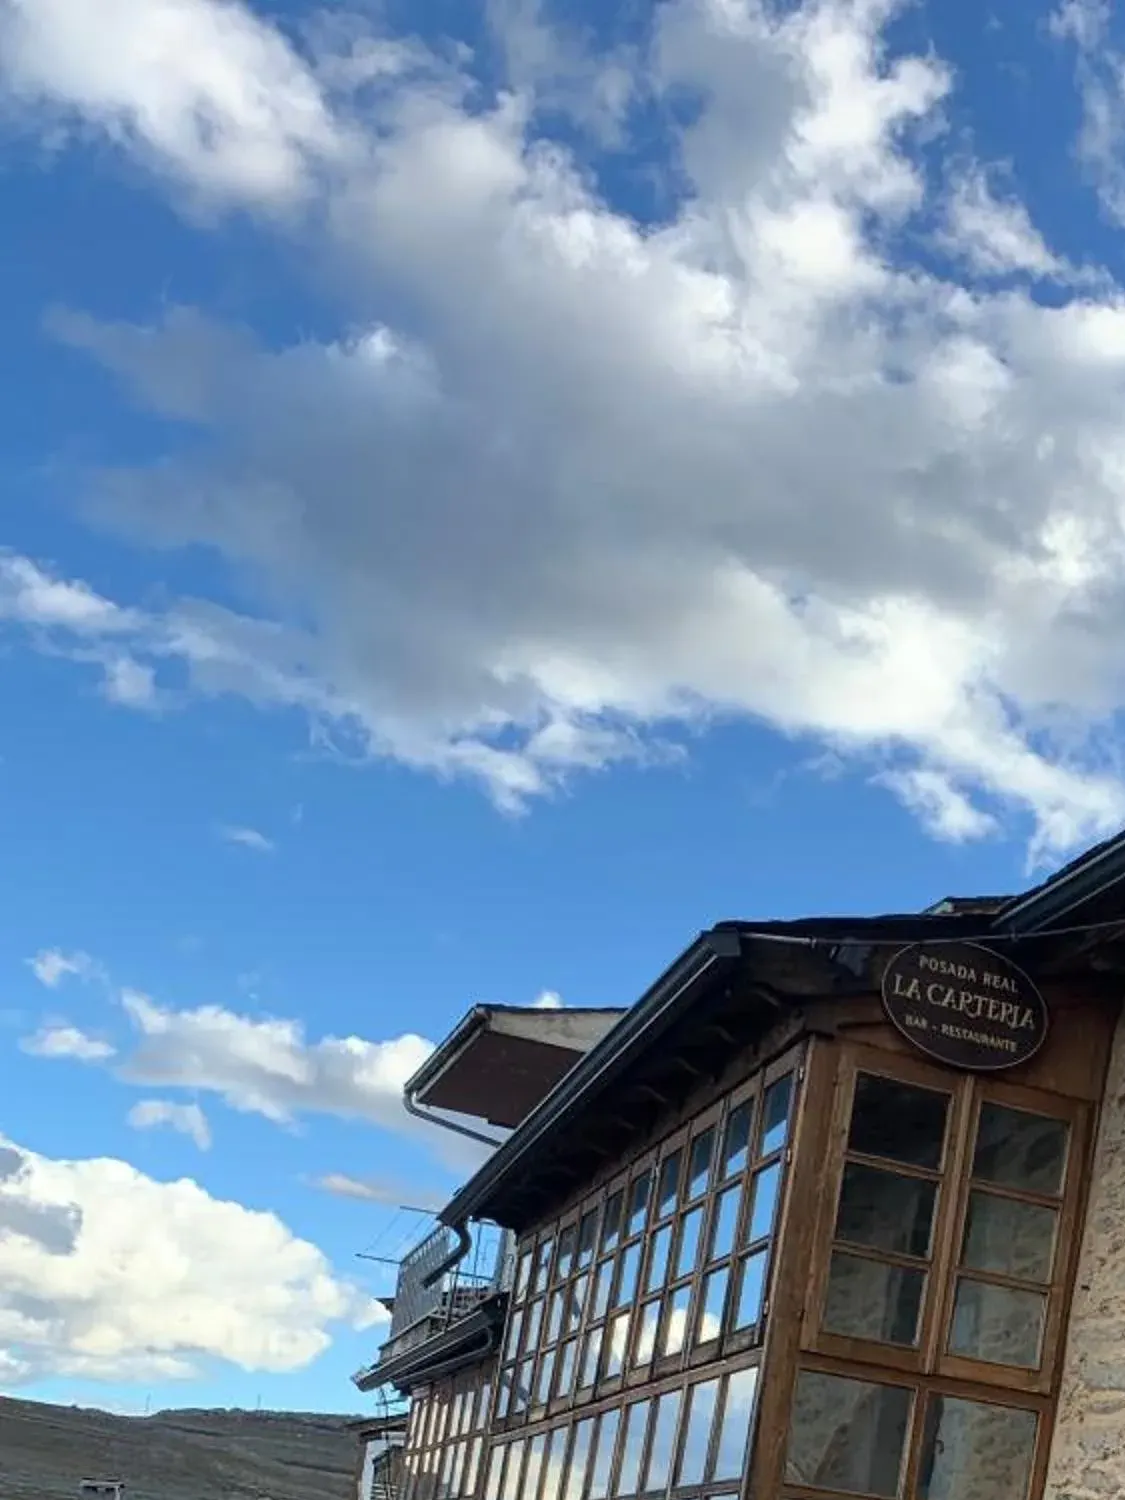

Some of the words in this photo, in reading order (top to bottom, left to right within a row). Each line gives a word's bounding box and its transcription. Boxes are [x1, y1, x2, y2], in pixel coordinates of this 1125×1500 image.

[918, 955, 978, 983] POSADA
[983, 971, 1019, 994] REAL
[892, 973, 922, 1002] LA
[926, 982, 1036, 1031] CARTERIA
[904, 1013, 929, 1031] BAR
[941, 1022, 1018, 1053] RESTAURANTE
